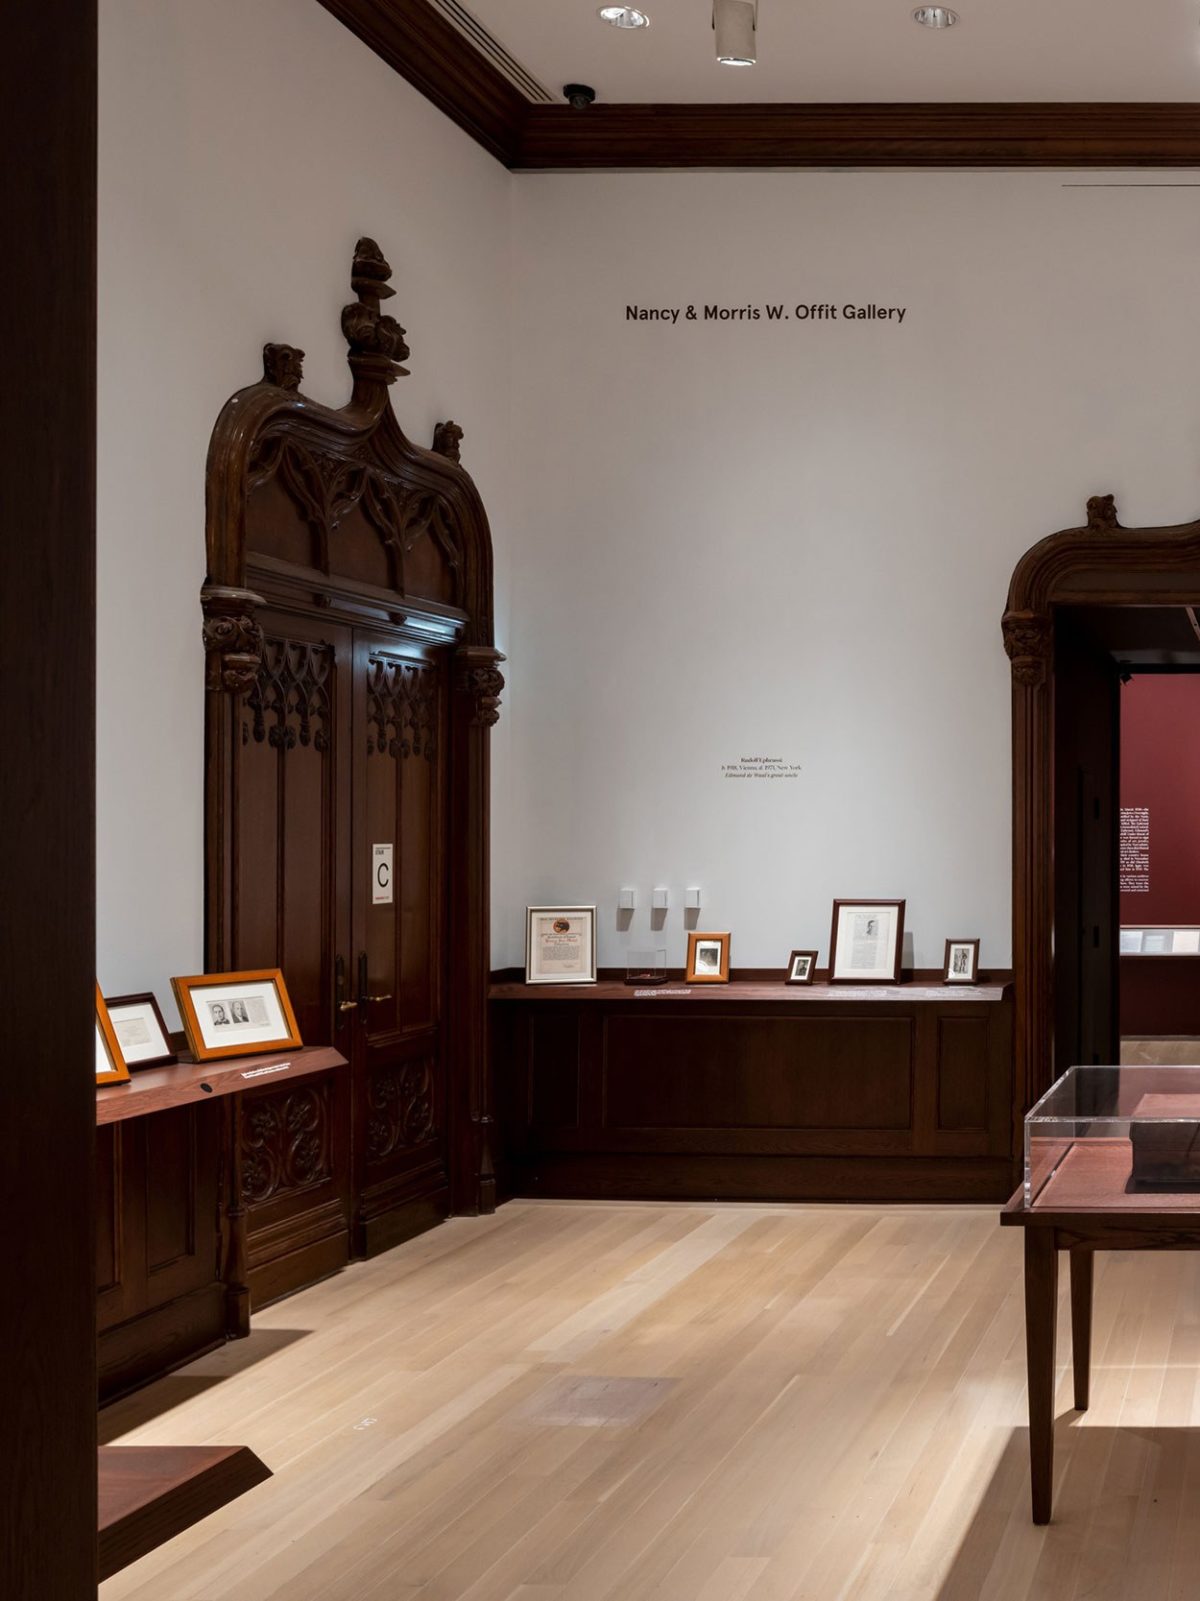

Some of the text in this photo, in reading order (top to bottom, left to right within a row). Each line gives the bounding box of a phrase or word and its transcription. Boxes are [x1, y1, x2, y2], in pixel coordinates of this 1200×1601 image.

[626, 304, 906, 324] Nancy & Morris W. Offit Gallery
[378, 862, 389, 888] C
